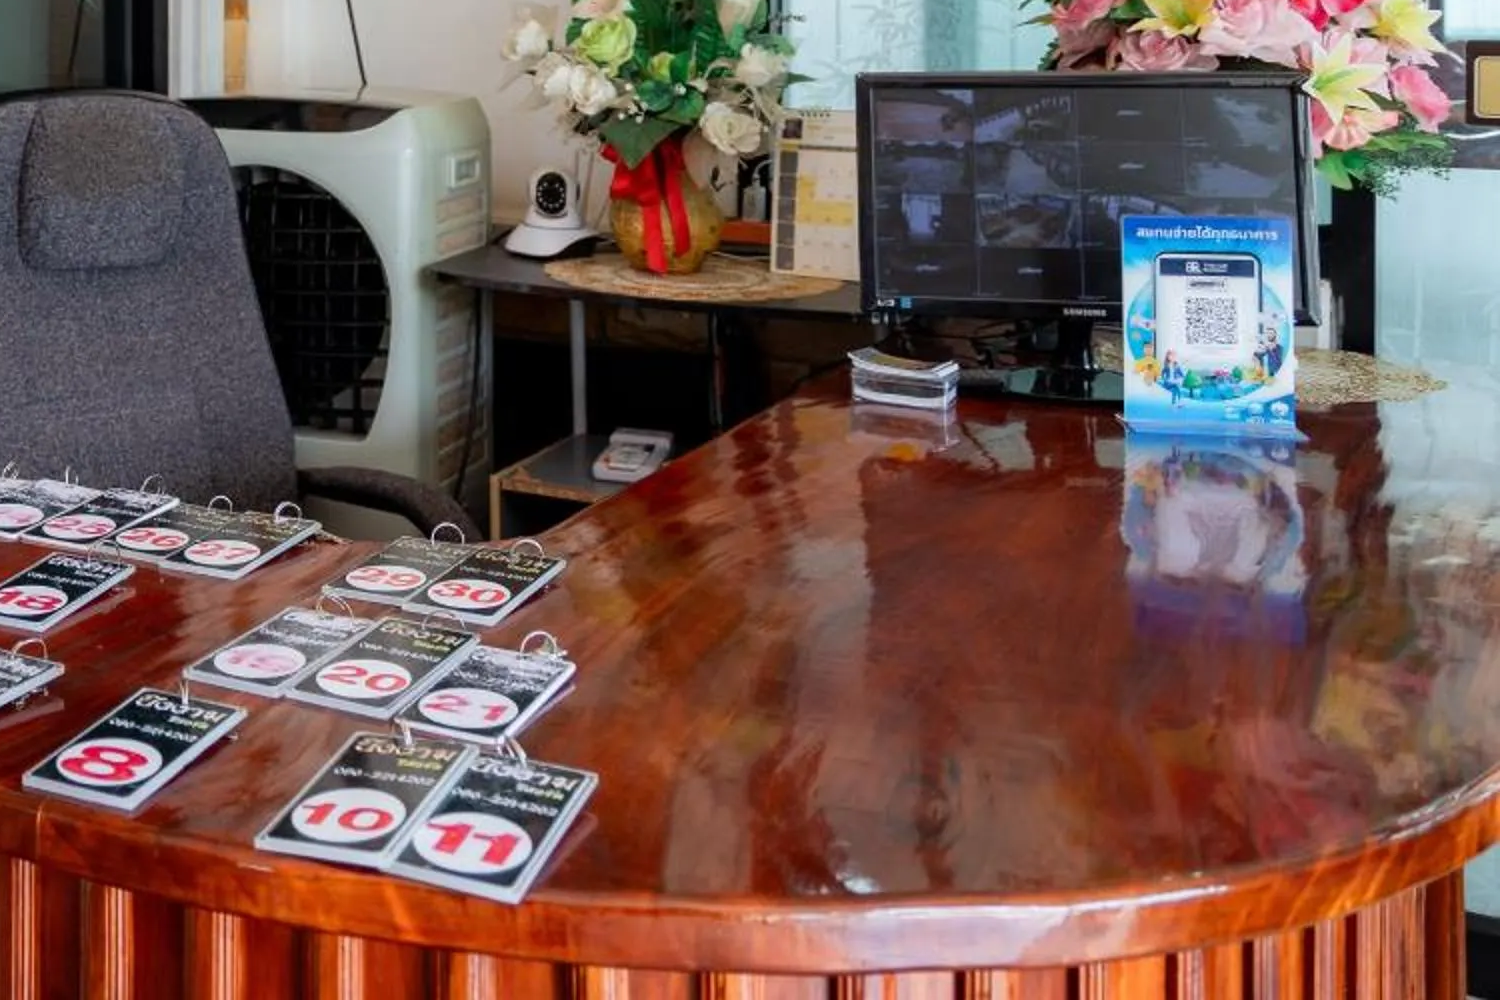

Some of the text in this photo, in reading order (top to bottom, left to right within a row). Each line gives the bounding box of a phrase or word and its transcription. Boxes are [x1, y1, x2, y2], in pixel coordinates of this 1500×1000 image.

[433, 580, 508, 606] 30
[320, 664, 409, 693] 20
[422, 692, 510, 724] 21
[59, 745, 149, 782] 8
[300, 802, 395, 832] 10
[426, 821, 523, 867] 11
